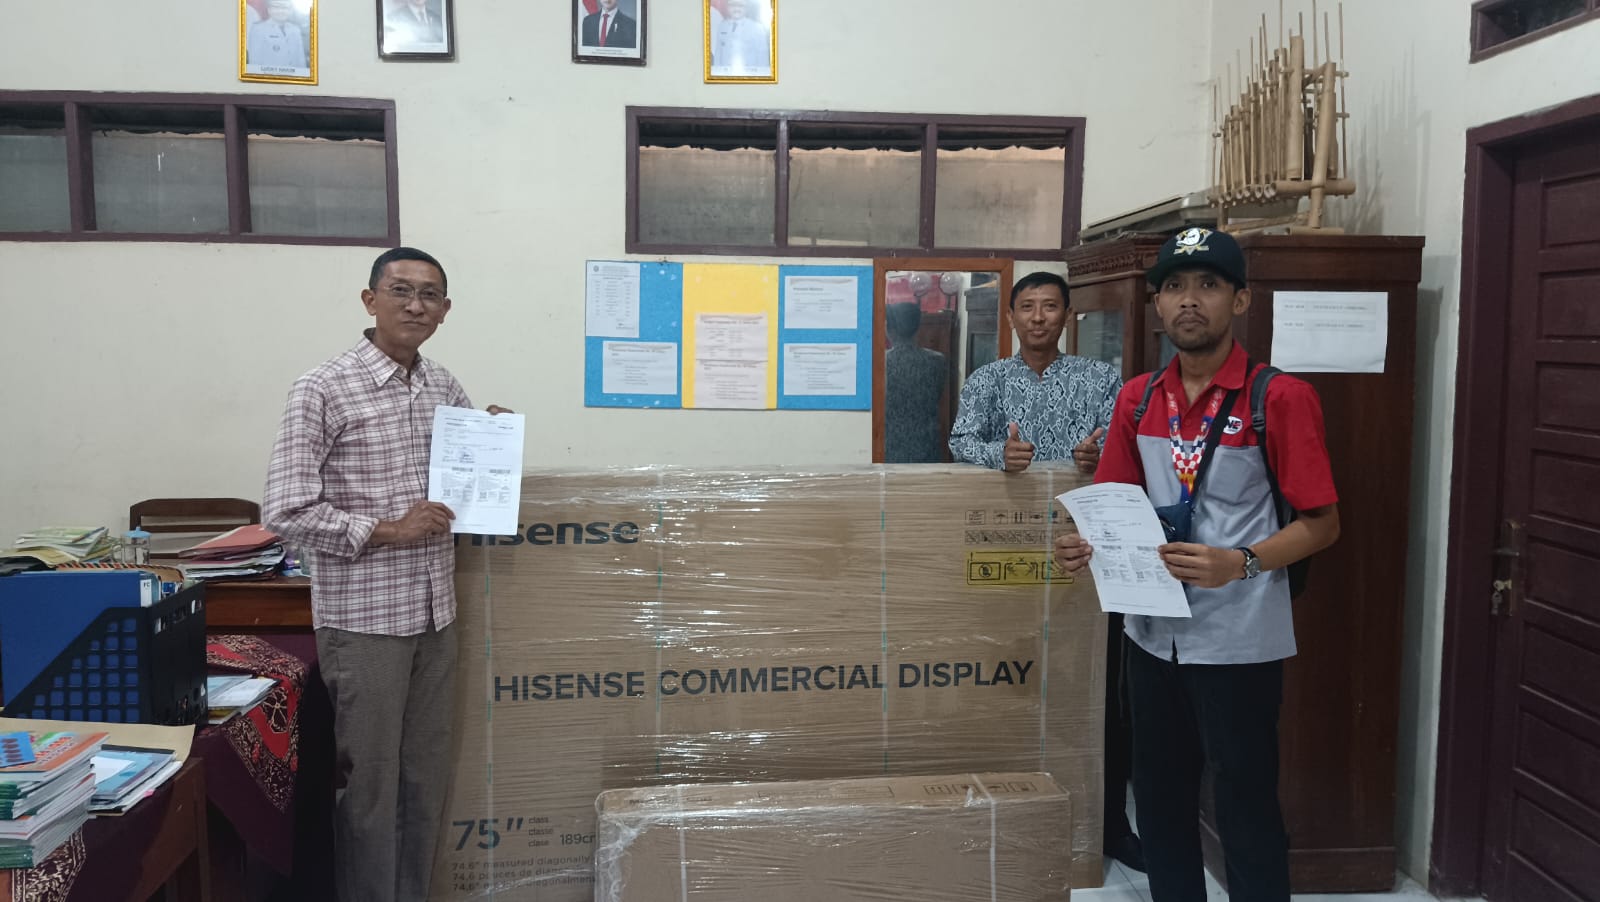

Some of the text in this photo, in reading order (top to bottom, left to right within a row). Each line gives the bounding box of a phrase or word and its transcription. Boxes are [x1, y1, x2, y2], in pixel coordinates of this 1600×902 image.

[454, 521, 639, 546] sense
[494, 660, 1034, 701] HISENSE COMMERCIAL DISPLAY
[453, 817, 524, 851] 75"
